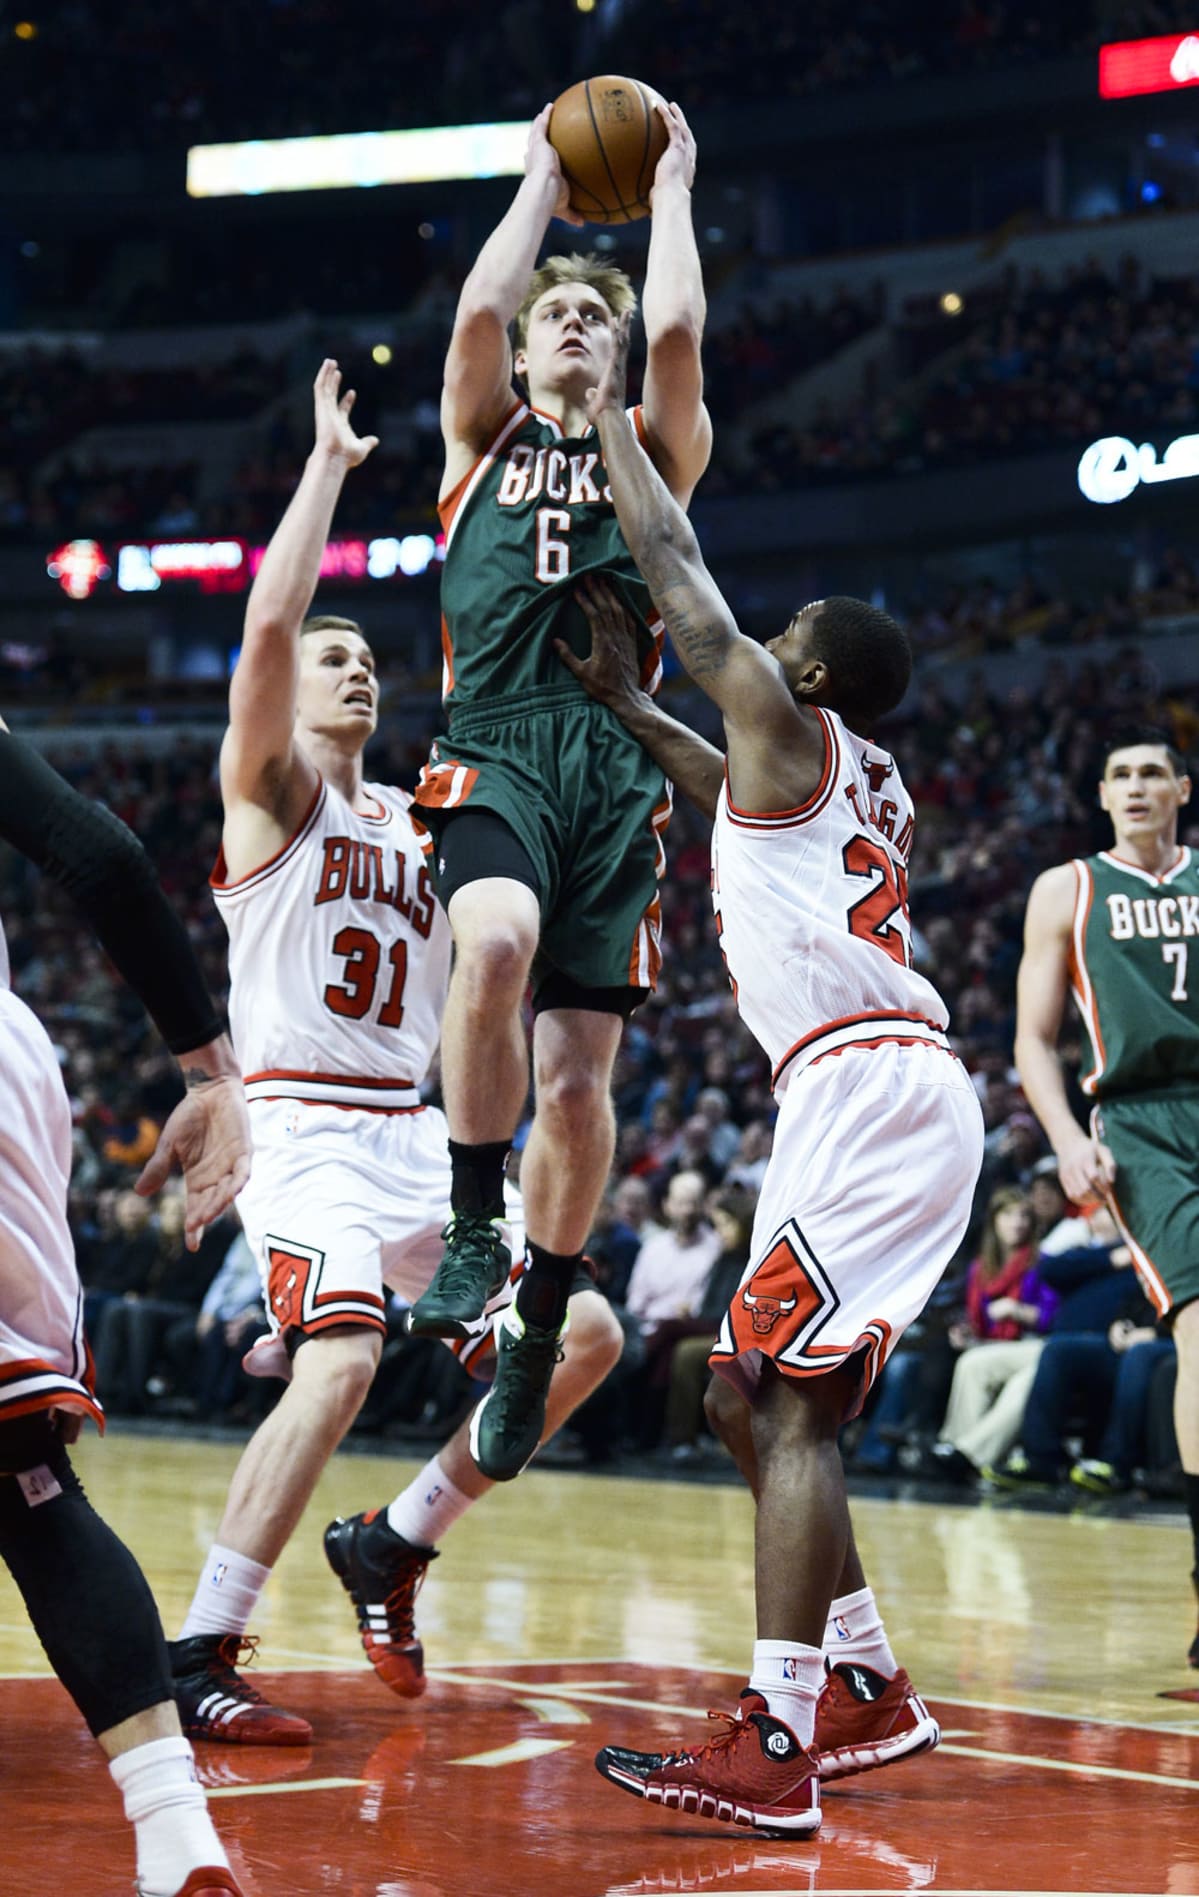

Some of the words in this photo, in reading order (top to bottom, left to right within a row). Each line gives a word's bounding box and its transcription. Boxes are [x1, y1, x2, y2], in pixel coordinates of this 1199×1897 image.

[496, 444, 613, 505] BUCK
[535, 507, 571, 583] 6
[314, 836, 434, 940] BULLS
[842, 834, 913, 968] 2
[324, 926, 407, 1029] 31
[1162, 942, 1188, 1001] 7
